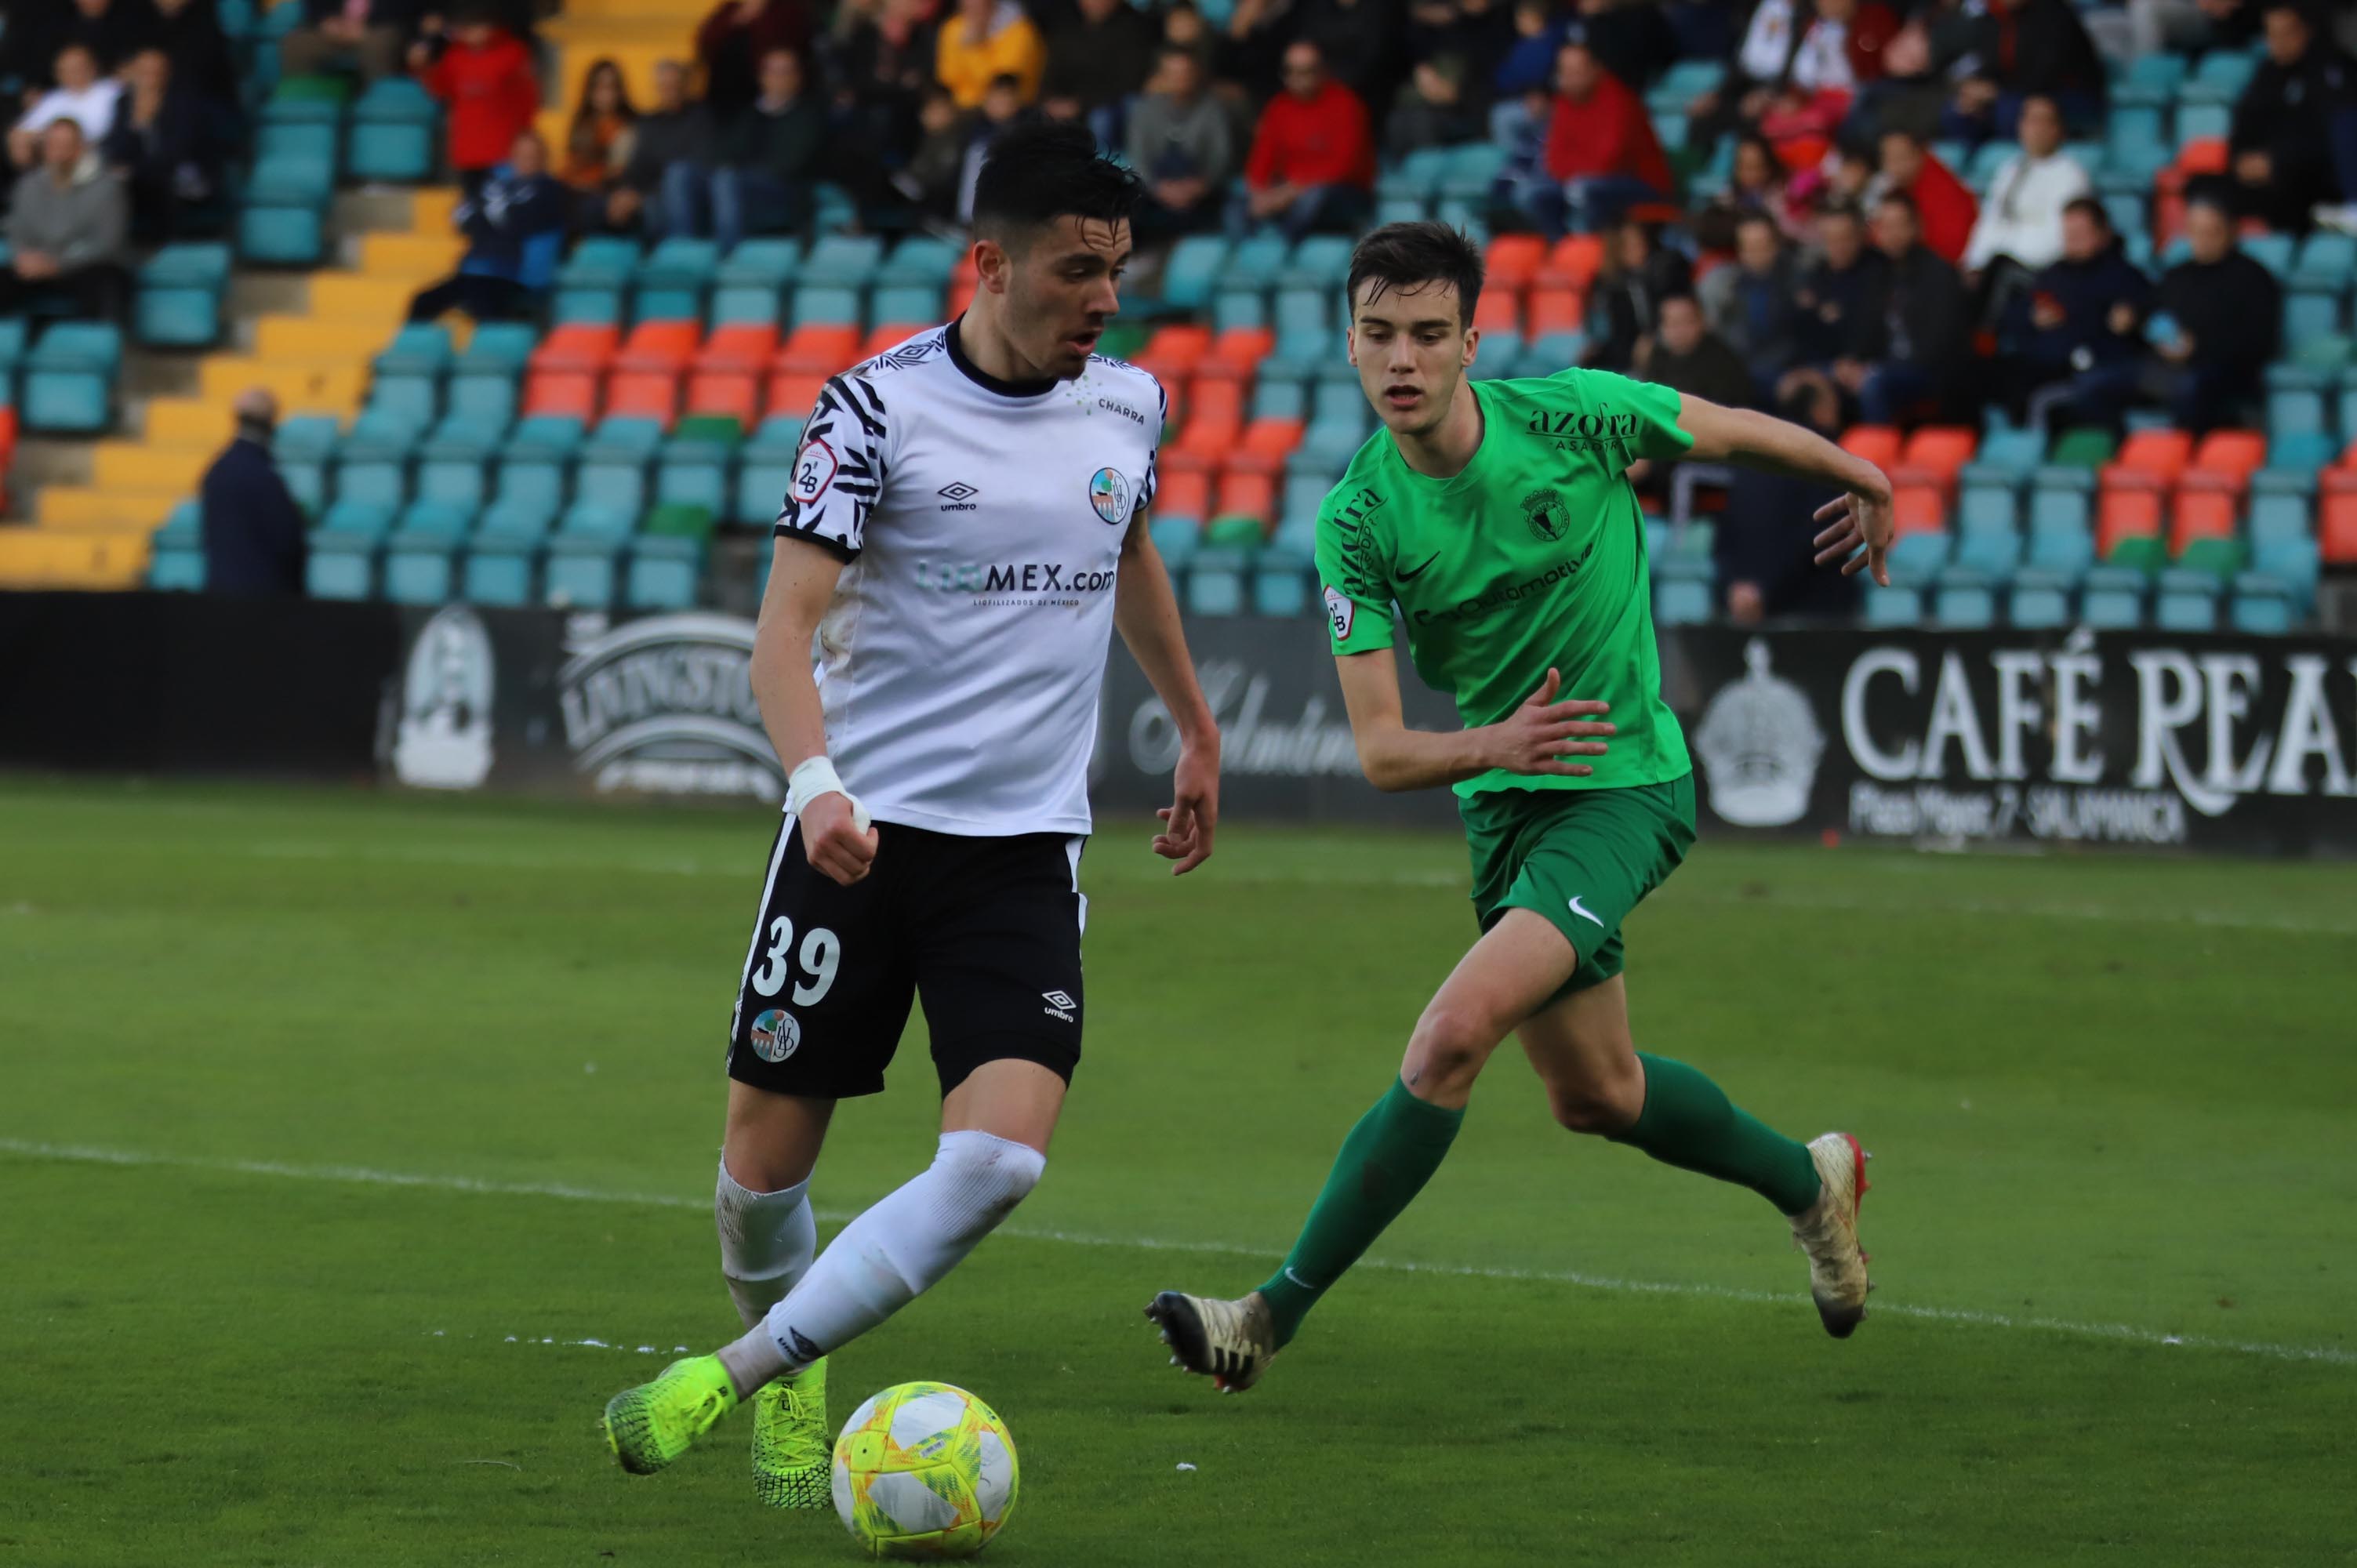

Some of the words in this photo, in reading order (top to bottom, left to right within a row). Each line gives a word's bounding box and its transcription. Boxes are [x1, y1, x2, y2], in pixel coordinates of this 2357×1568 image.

[1099, 398, 1145, 425] CHARRA
[1051, 597, 1080, 607] MÉXICO
[1840, 626, 2105, 784] CAFÉ
[2129, 649, 2357, 817] REA
[751, 915, 841, 1007] 39
[1044, 1007, 1073, 1022] umbro
